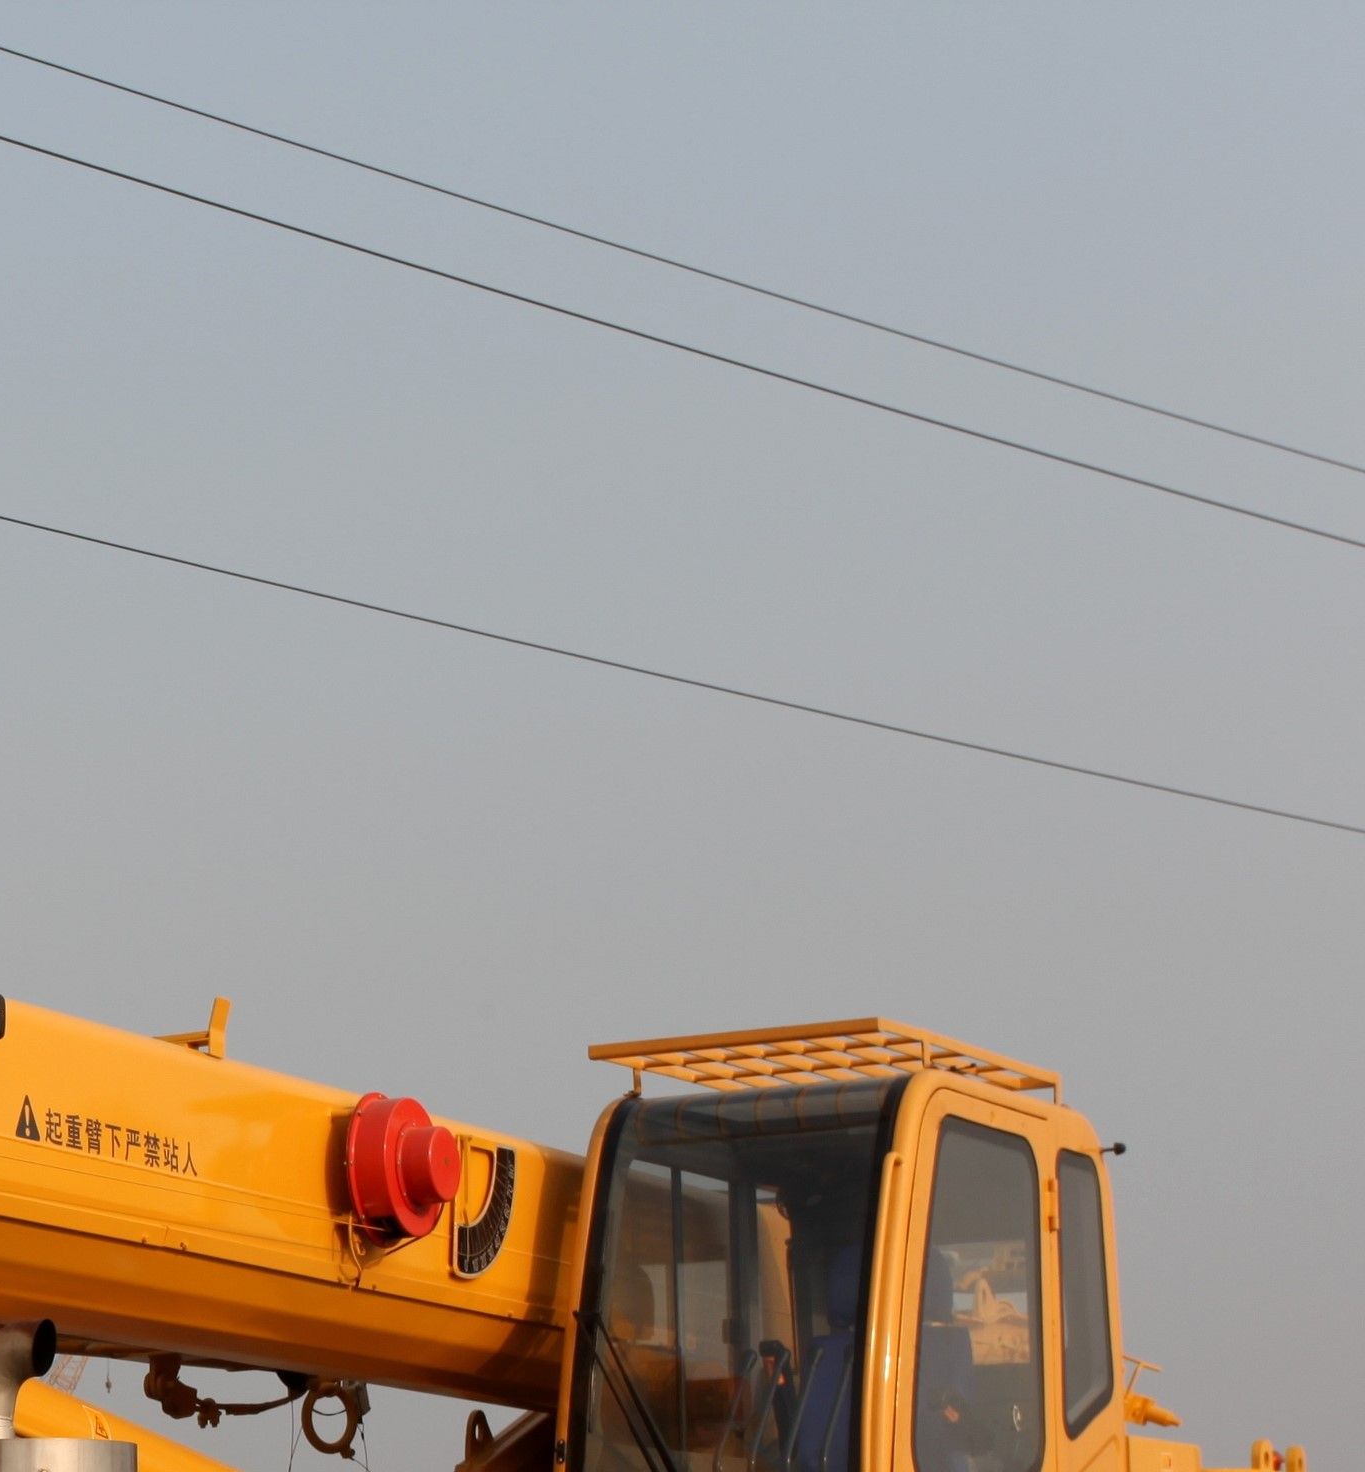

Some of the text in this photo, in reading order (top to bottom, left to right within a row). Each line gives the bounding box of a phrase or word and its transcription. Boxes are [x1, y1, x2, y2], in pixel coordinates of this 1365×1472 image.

[44, 1108, 198, 1177] 起重臂下严禁站人
